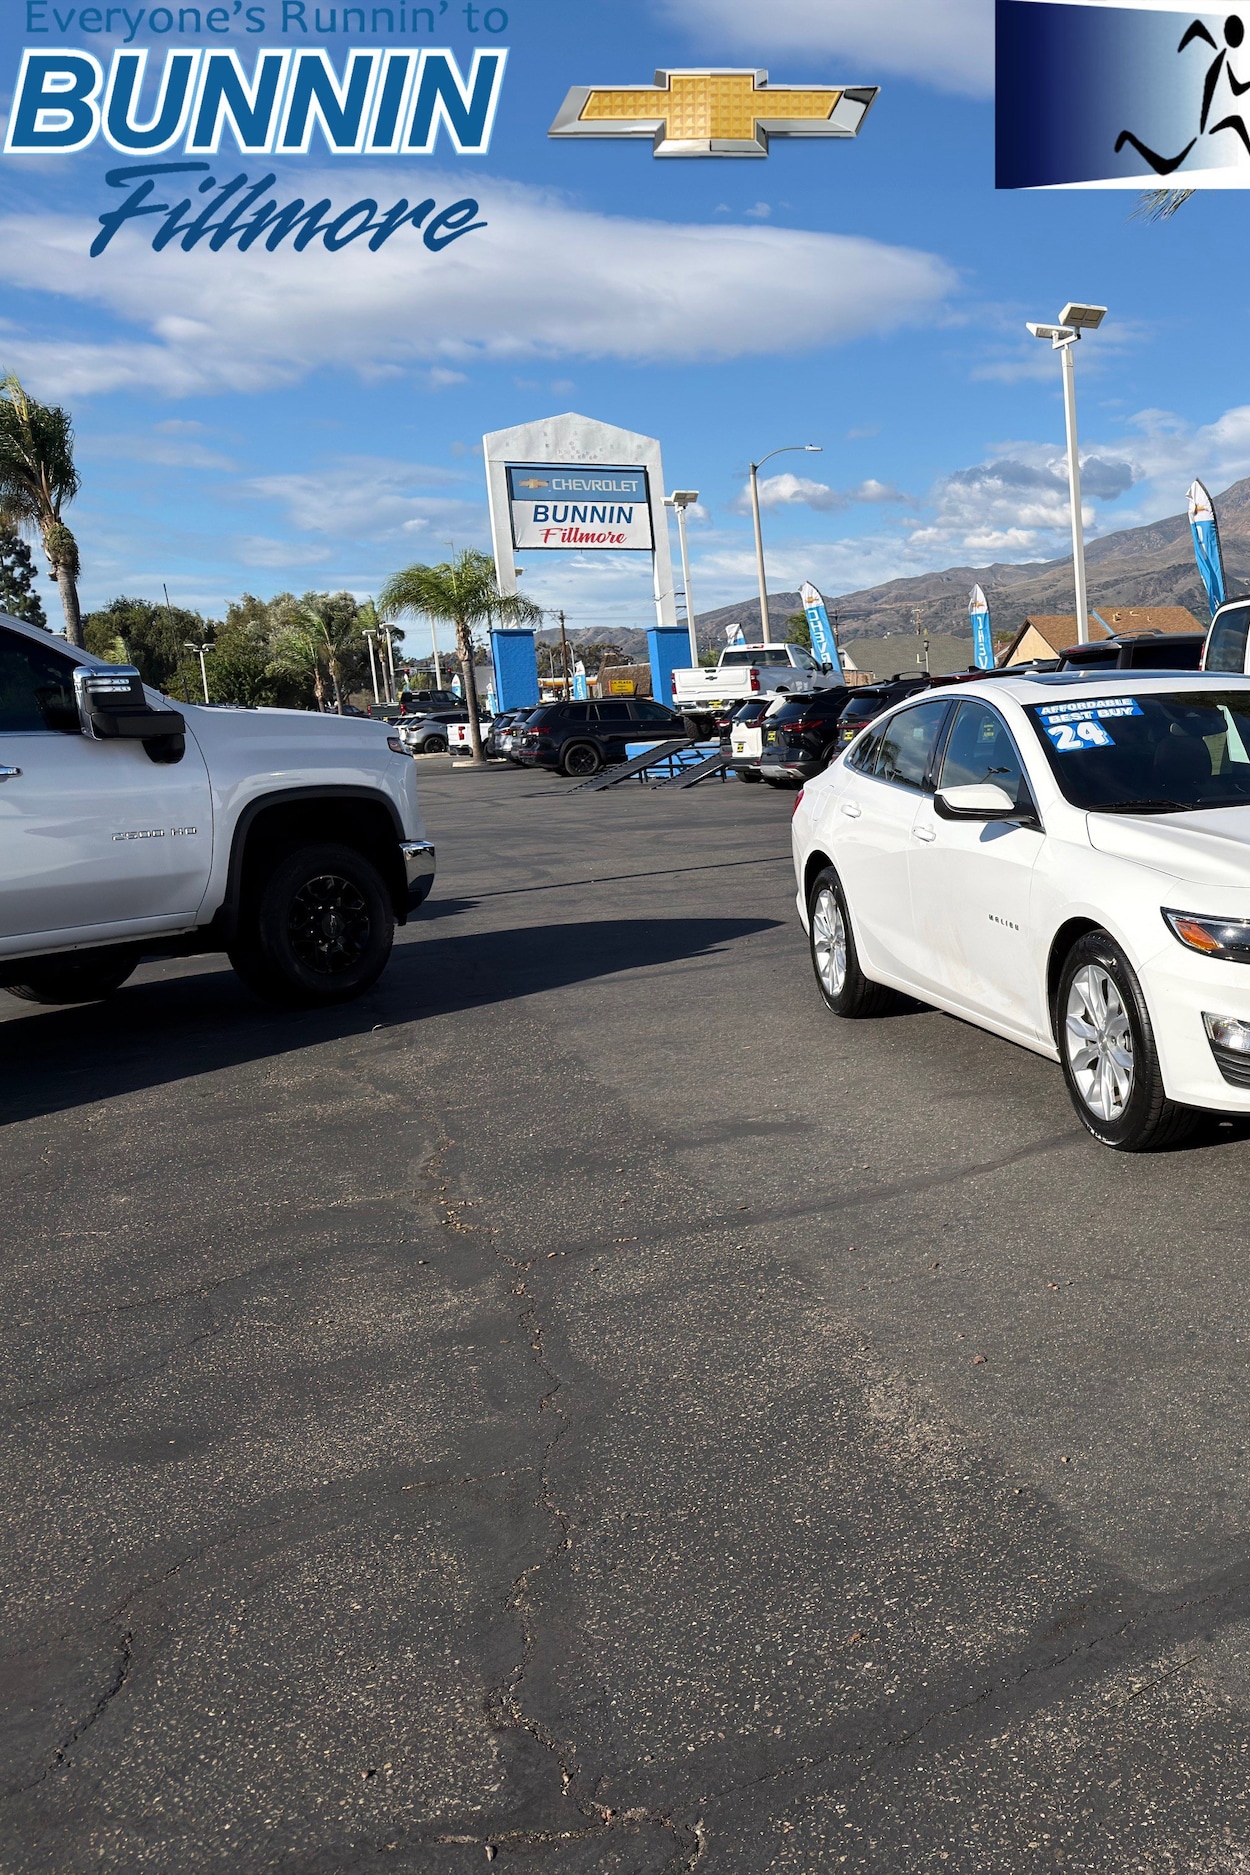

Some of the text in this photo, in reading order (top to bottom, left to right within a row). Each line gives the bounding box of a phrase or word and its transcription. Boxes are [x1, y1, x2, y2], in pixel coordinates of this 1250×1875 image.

[552, 478, 638, 492] CHEVROLET
[533, 504, 633, 524] BUNNIN
[539, 527, 627, 544] Fillmore
[1041, 698, 1133, 715] AFFORDABLE
[1048, 706, 1134, 724] BEST BUY
[1047, 721, 1110, 750] 24
[112, 827, 197, 840] 2500 HD
[988, 913, 1019, 931] MALIBU
